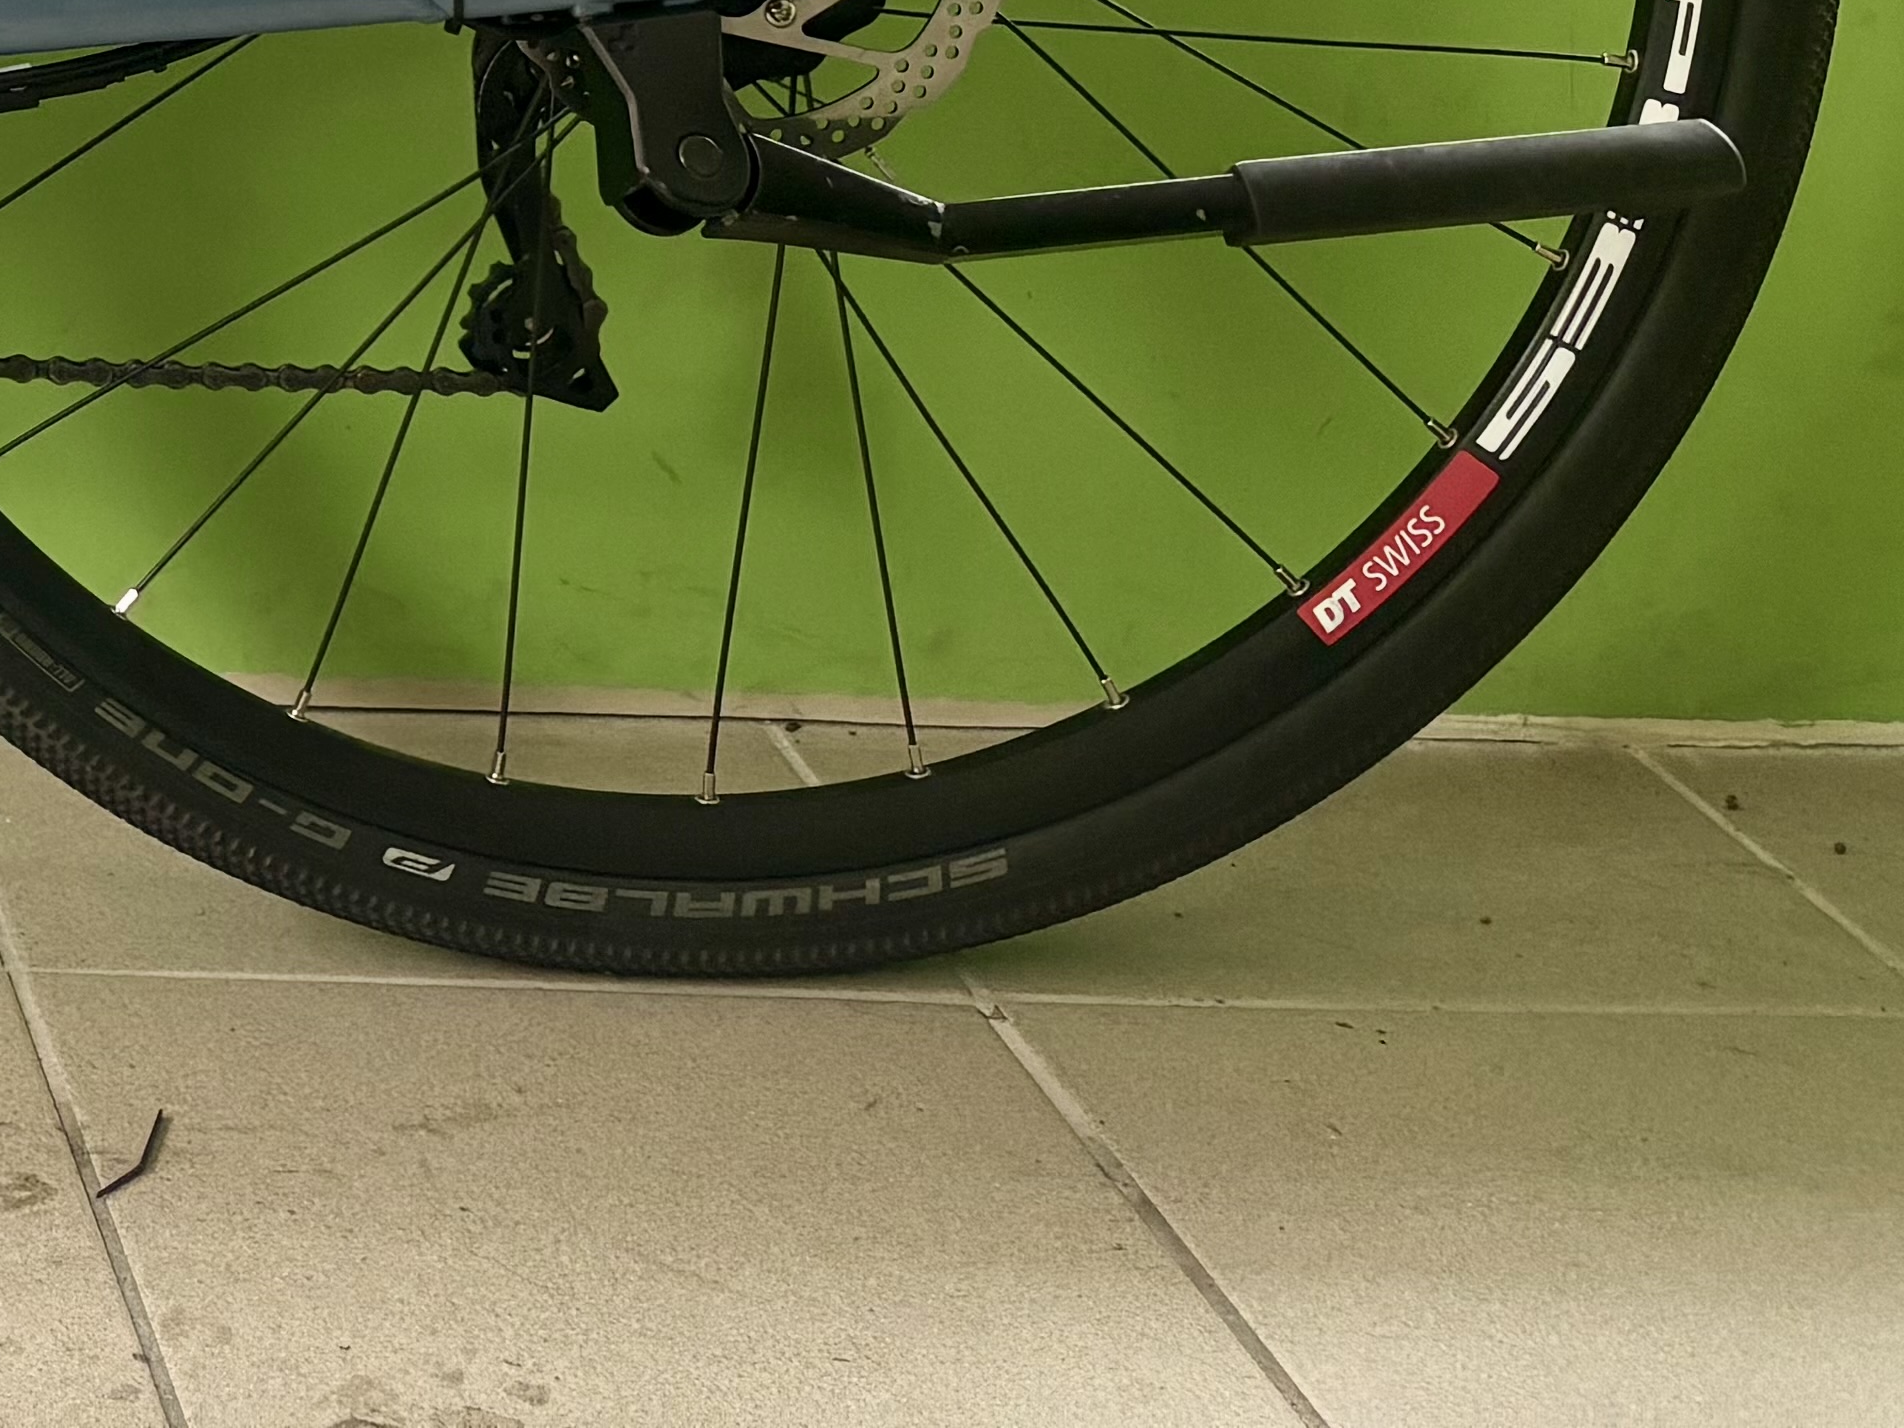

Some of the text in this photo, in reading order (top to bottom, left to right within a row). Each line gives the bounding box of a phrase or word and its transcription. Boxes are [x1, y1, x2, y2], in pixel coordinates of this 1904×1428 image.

[1312, 504, 1446, 635] DT SWISS
[94, 697, 353, 851] G-ONE
[483, 847, 1009, 918] SCHWALBE
